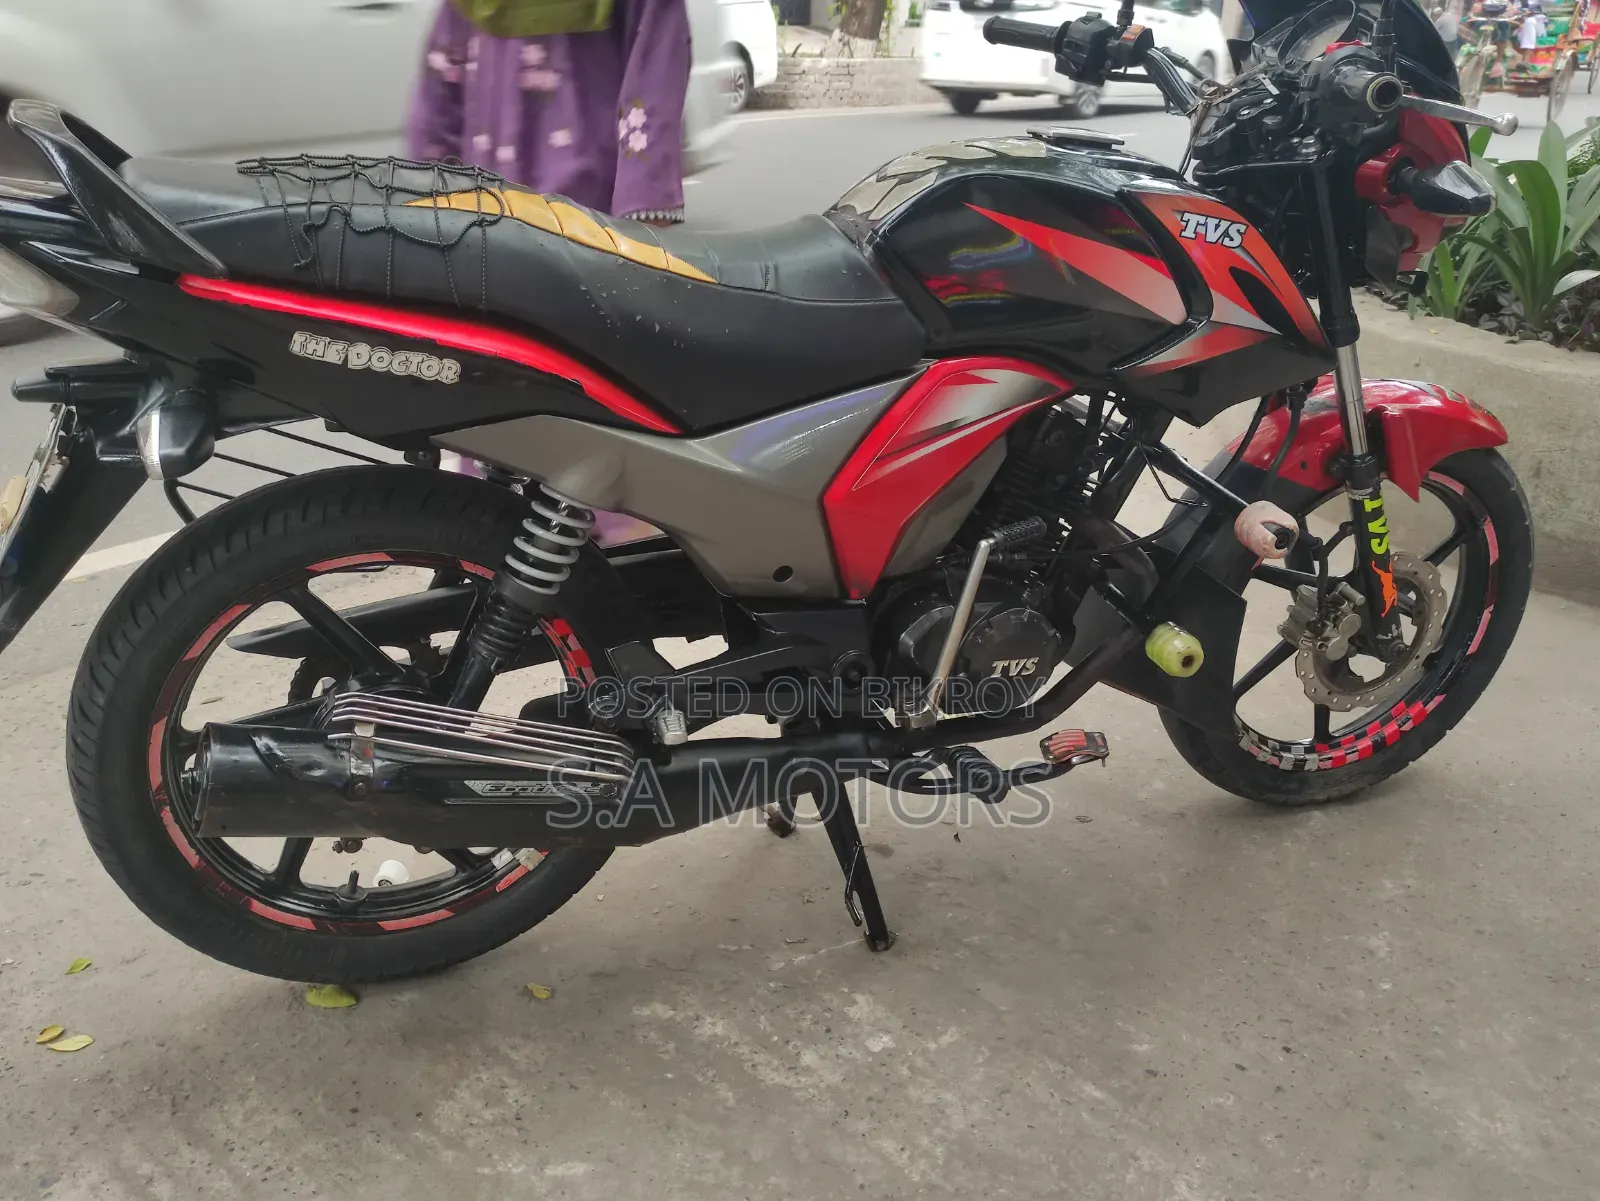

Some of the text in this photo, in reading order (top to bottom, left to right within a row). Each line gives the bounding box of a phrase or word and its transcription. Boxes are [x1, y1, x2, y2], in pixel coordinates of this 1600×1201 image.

[1179, 211, 1249, 249] TVS
[289, 331, 462, 384] THE DOCTOR
[990, 657, 1040, 678] TVS
